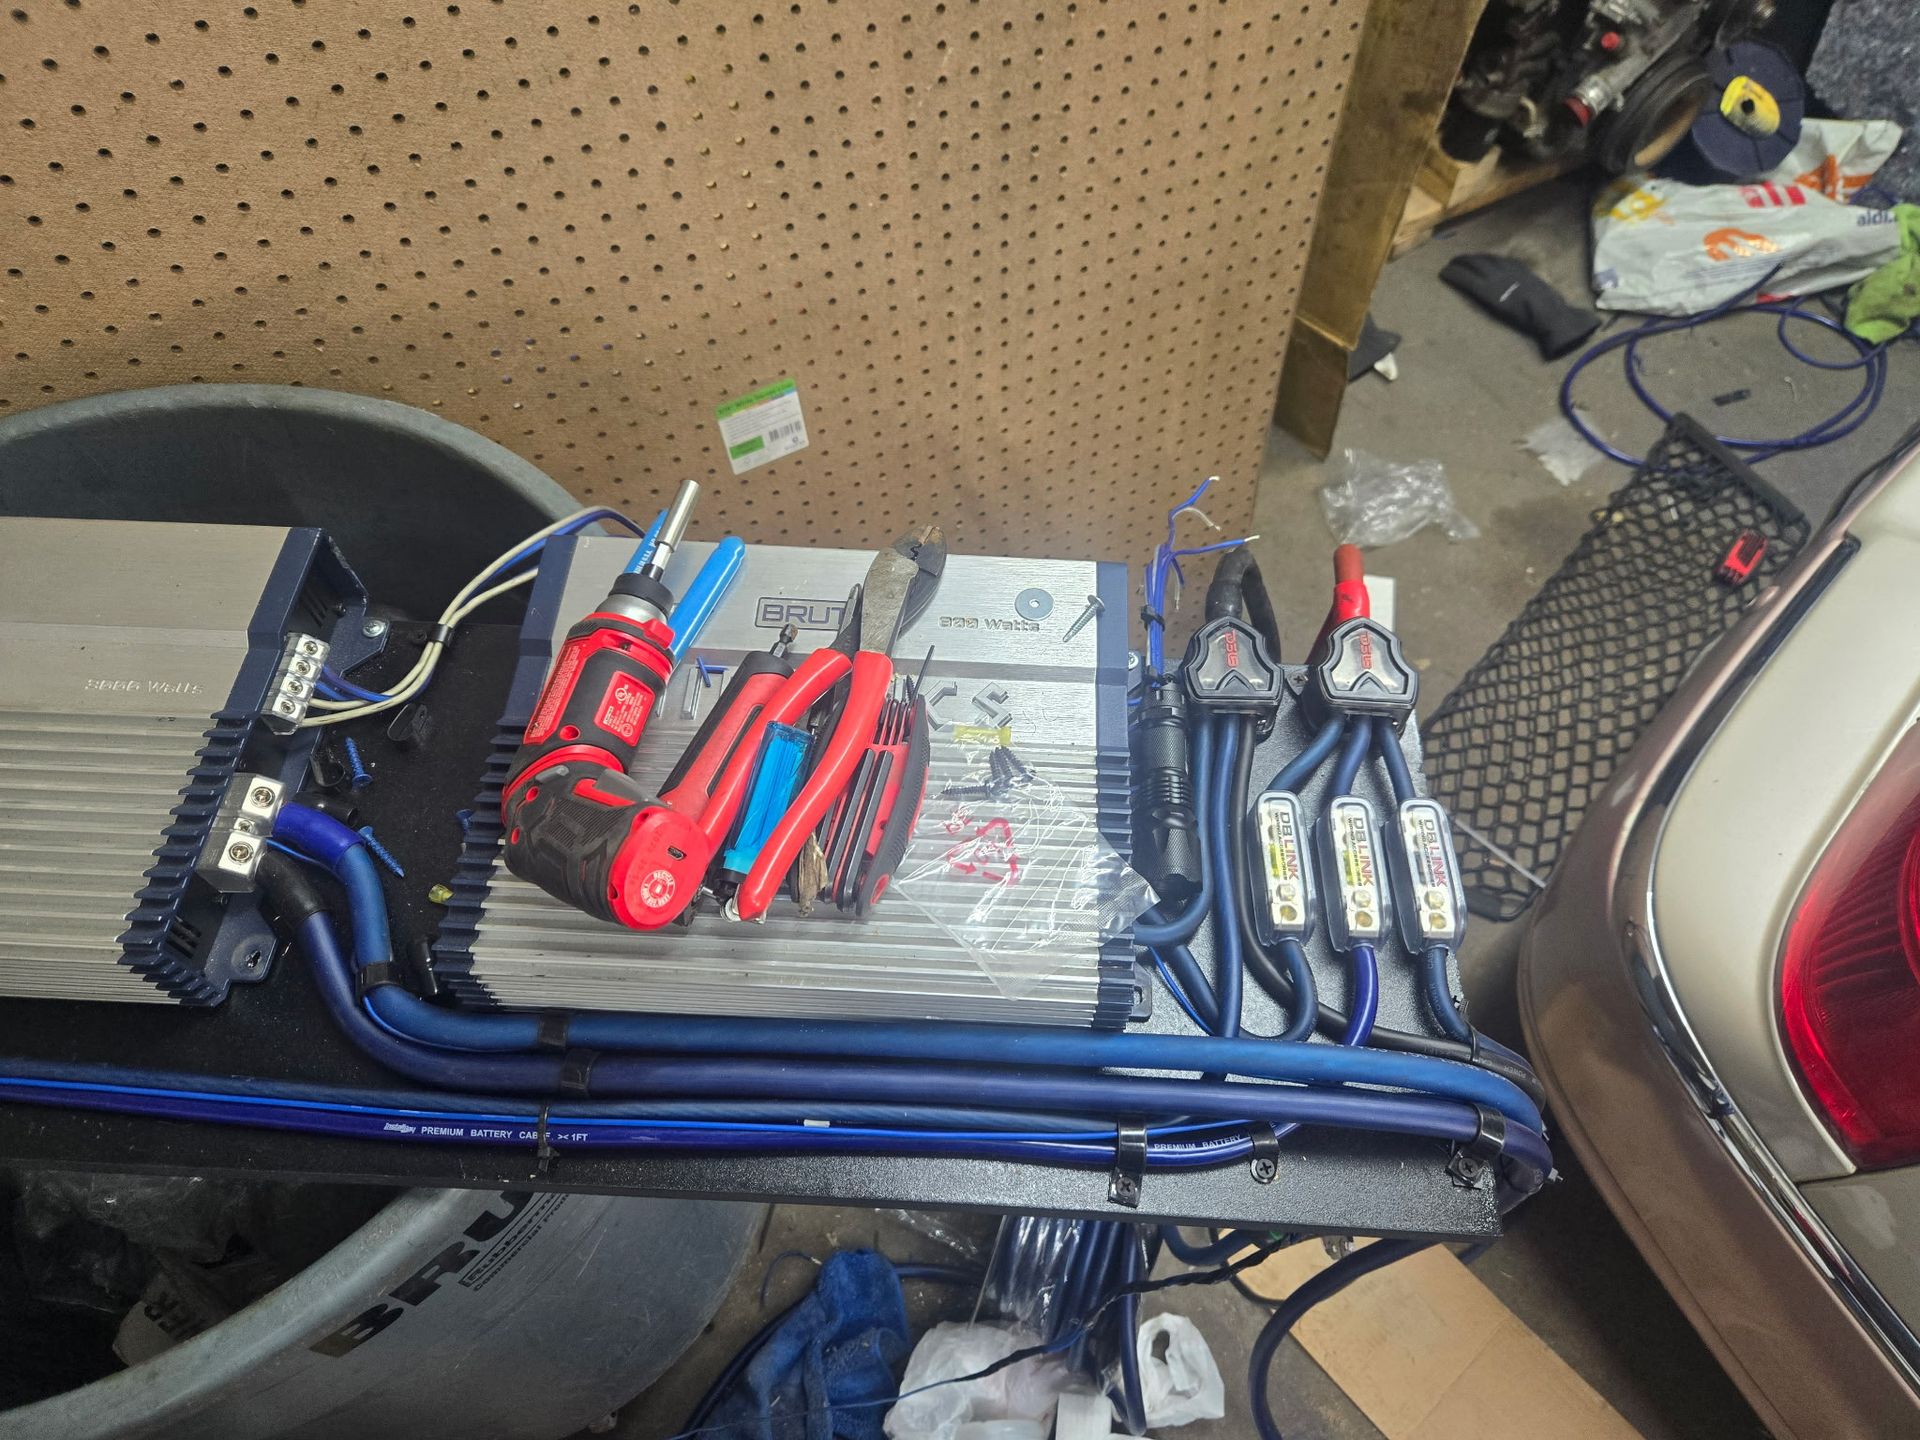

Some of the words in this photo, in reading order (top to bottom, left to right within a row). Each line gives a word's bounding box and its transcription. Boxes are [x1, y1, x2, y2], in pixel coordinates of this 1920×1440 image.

[984, 618, 1041, 633] Watts
[421, 1126, 464, 1137] PREMIUM
[470, 1129, 513, 1139] BATTERY
[1154, 1142, 1197, 1151] PREMIUM
[1202, 1134, 1240, 1149] BATTERY
